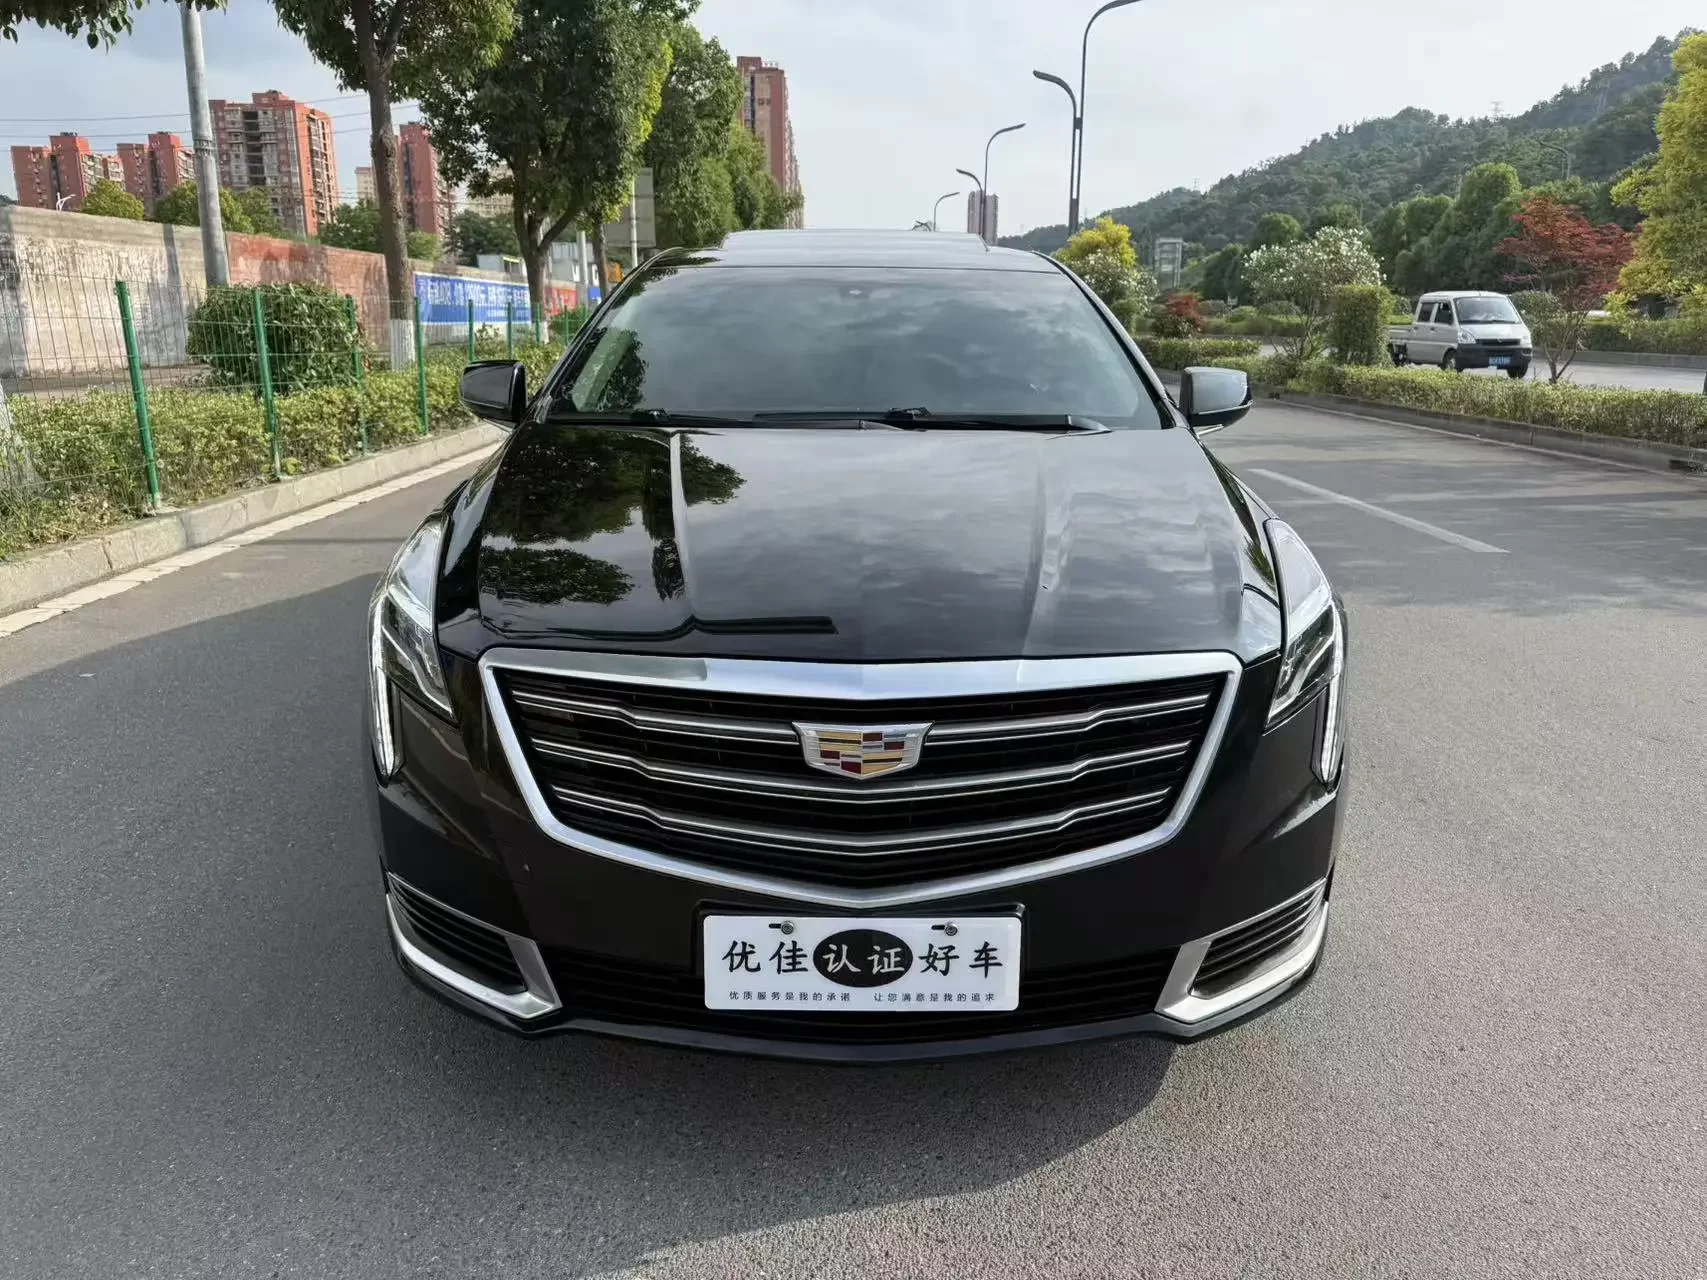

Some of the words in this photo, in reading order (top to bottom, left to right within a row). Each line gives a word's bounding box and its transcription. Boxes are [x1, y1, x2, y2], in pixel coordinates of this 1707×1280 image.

[721, 940, 1003, 978] 优佳认证好车
[729, 990, 850, 1002] 优质服务是我的承诺
[873, 992, 995, 1003] 让您满意是我的追求
